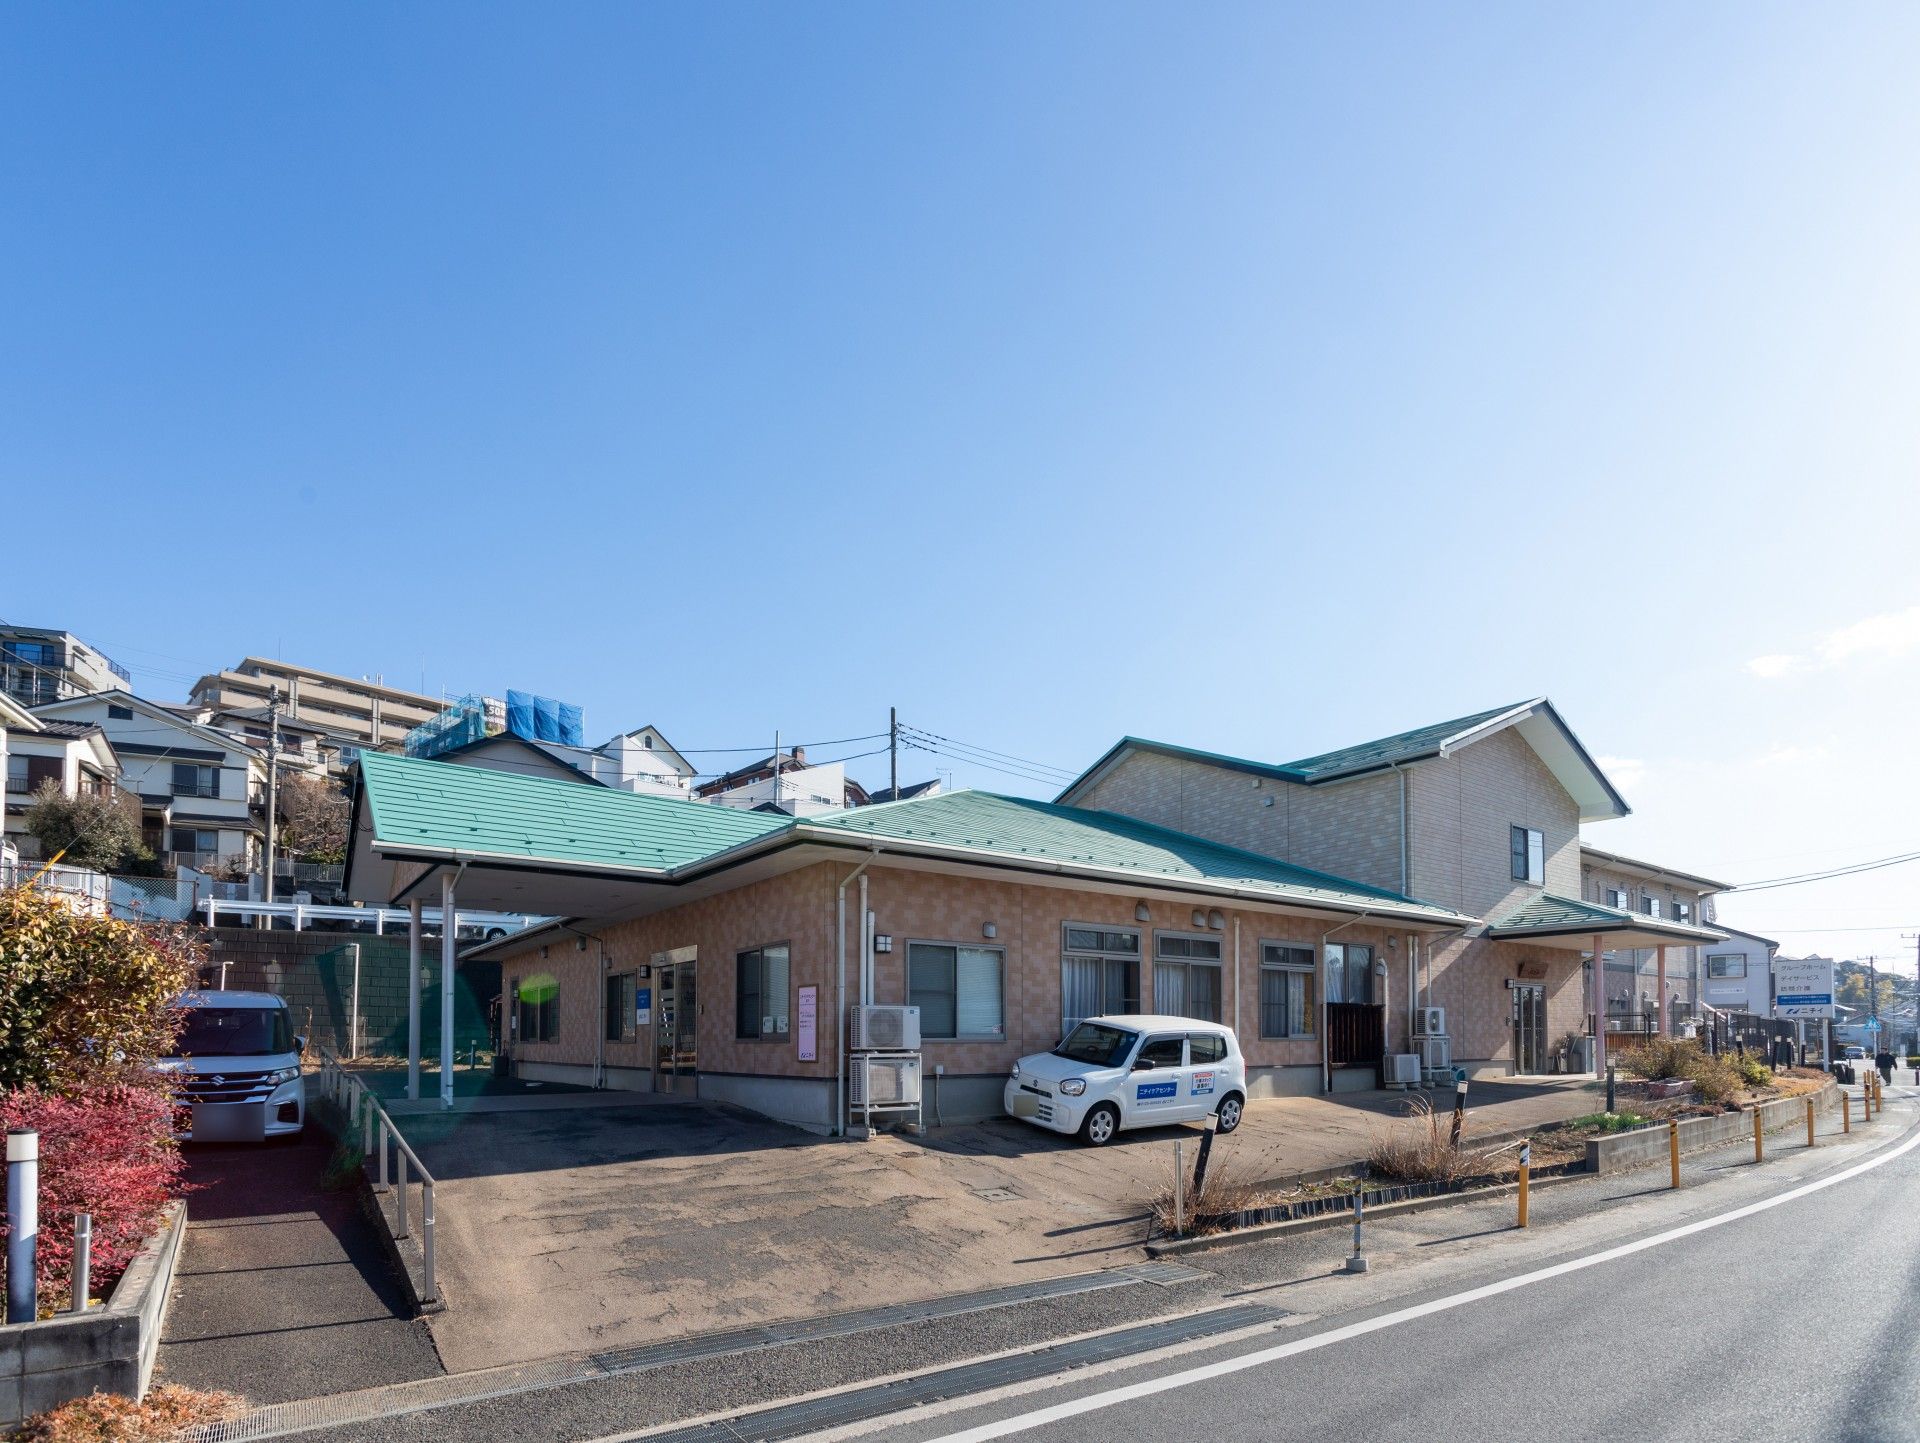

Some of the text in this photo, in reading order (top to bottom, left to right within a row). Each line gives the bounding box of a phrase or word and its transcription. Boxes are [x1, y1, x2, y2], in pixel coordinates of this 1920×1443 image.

[1139, 1086, 1175, 1095] ニチイケアセンター
